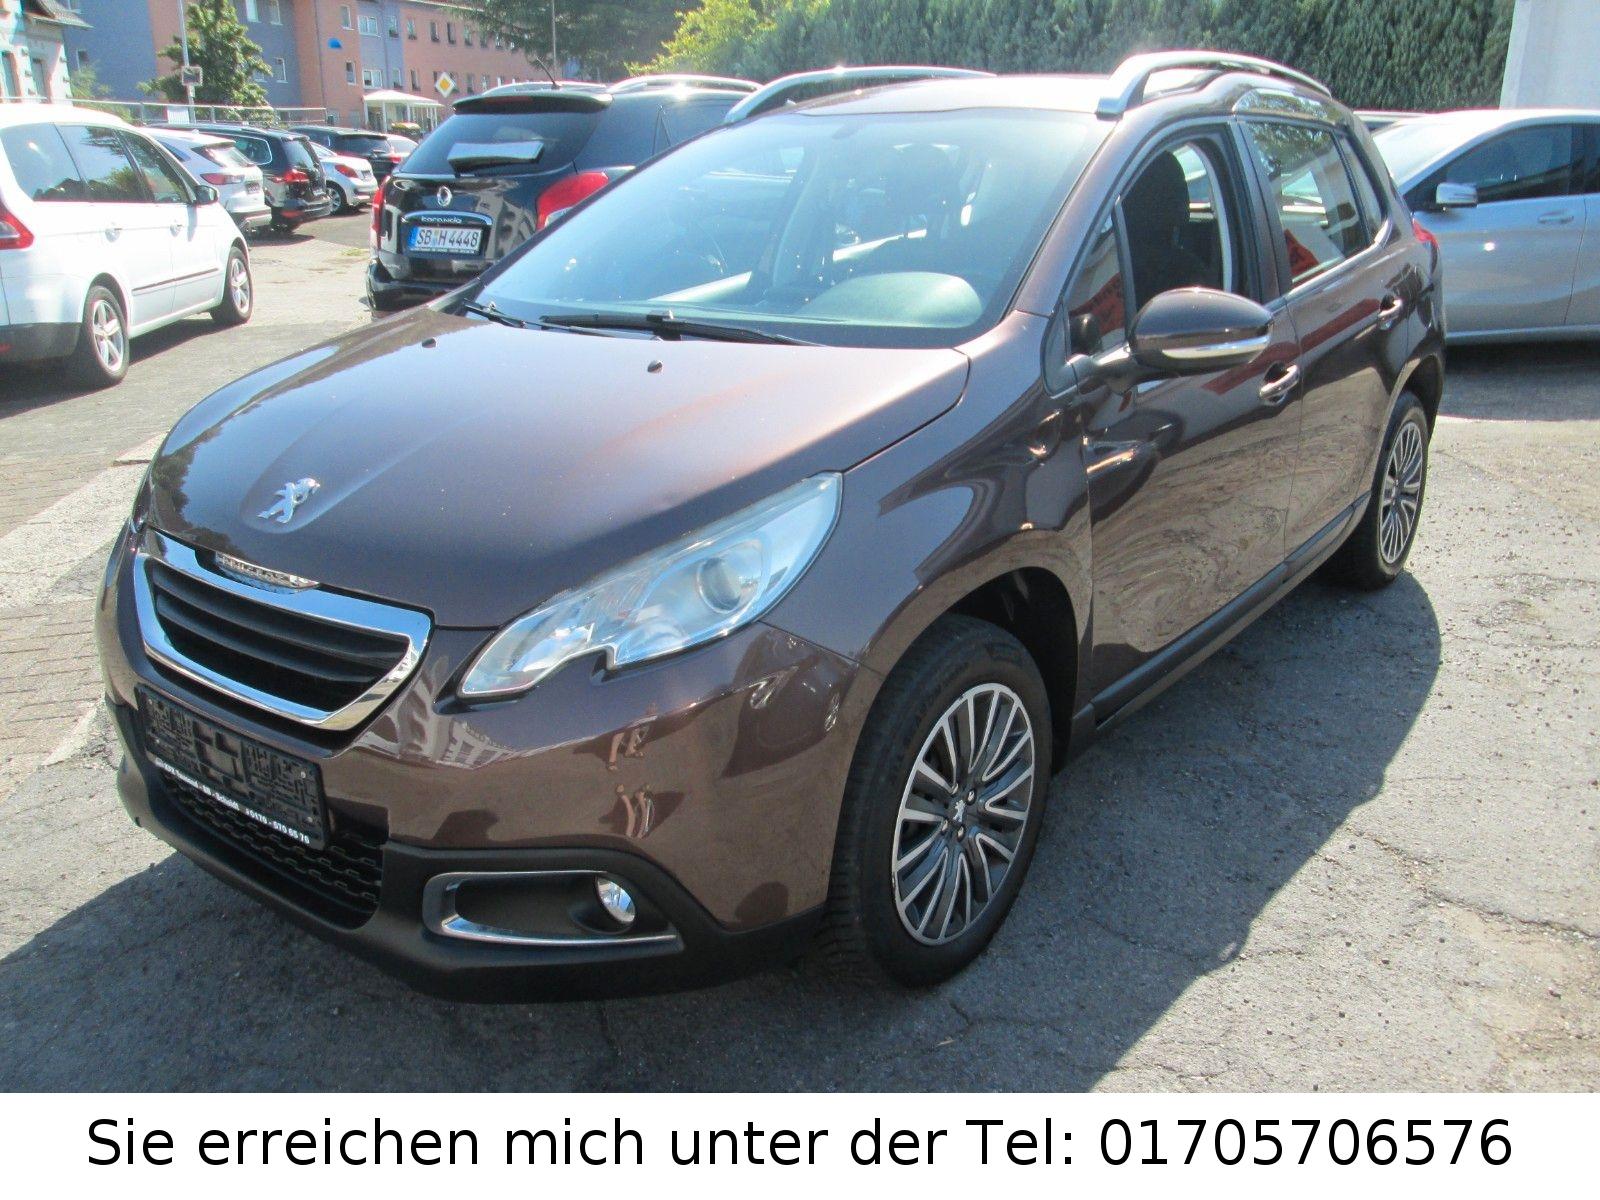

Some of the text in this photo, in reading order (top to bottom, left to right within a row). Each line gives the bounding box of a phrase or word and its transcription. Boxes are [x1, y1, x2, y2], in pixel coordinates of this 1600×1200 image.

[417, 229, 479, 247] SB H 4448
